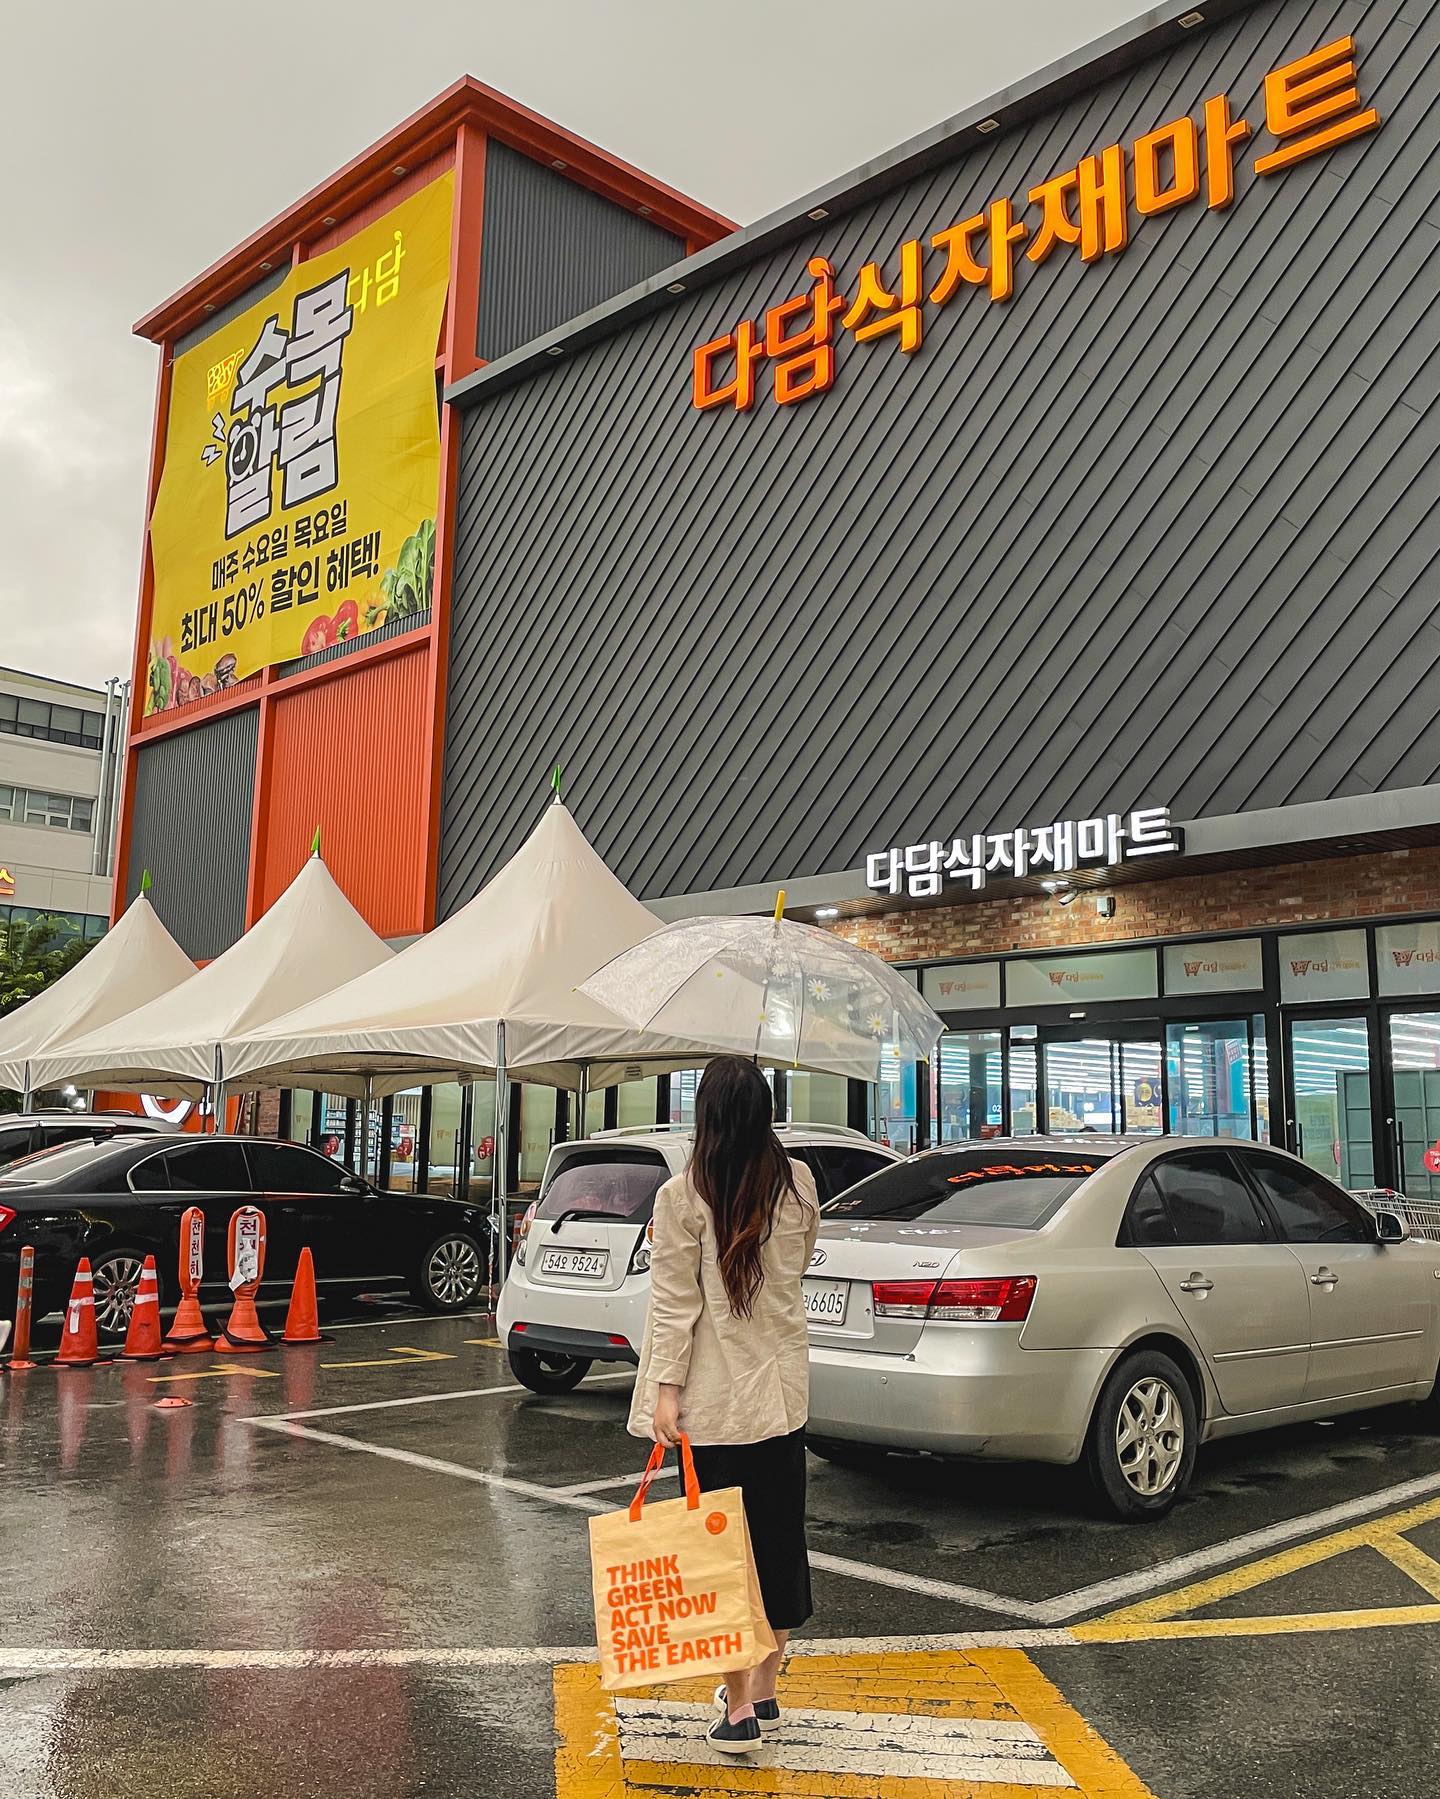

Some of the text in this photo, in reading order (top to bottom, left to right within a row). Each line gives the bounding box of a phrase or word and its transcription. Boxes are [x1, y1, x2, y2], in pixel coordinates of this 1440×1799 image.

[692, 34, 1381, 412] 다담식자재마트
[347, 230, 405, 314] 다담
[231, 267, 353, 413] 수목
[211, 499, 347, 591] 매주 수요일 목요일
[181, 530, 381, 654] 최대 50% 할인 혜택!
[866, 806, 1180, 898] 다담식자재마트
[190, 1219, 201, 1276] 천천히
[548, 1254, 599, 1272] 54오 9524
[606, 1554, 680, 1586] THINK
[607, 1575, 684, 1608] GREEN
[610, 1591, 717, 1631] ACT NOW
[612, 1623, 670, 1653] SAVE
[613, 1631, 742, 1674] THE EARTH
